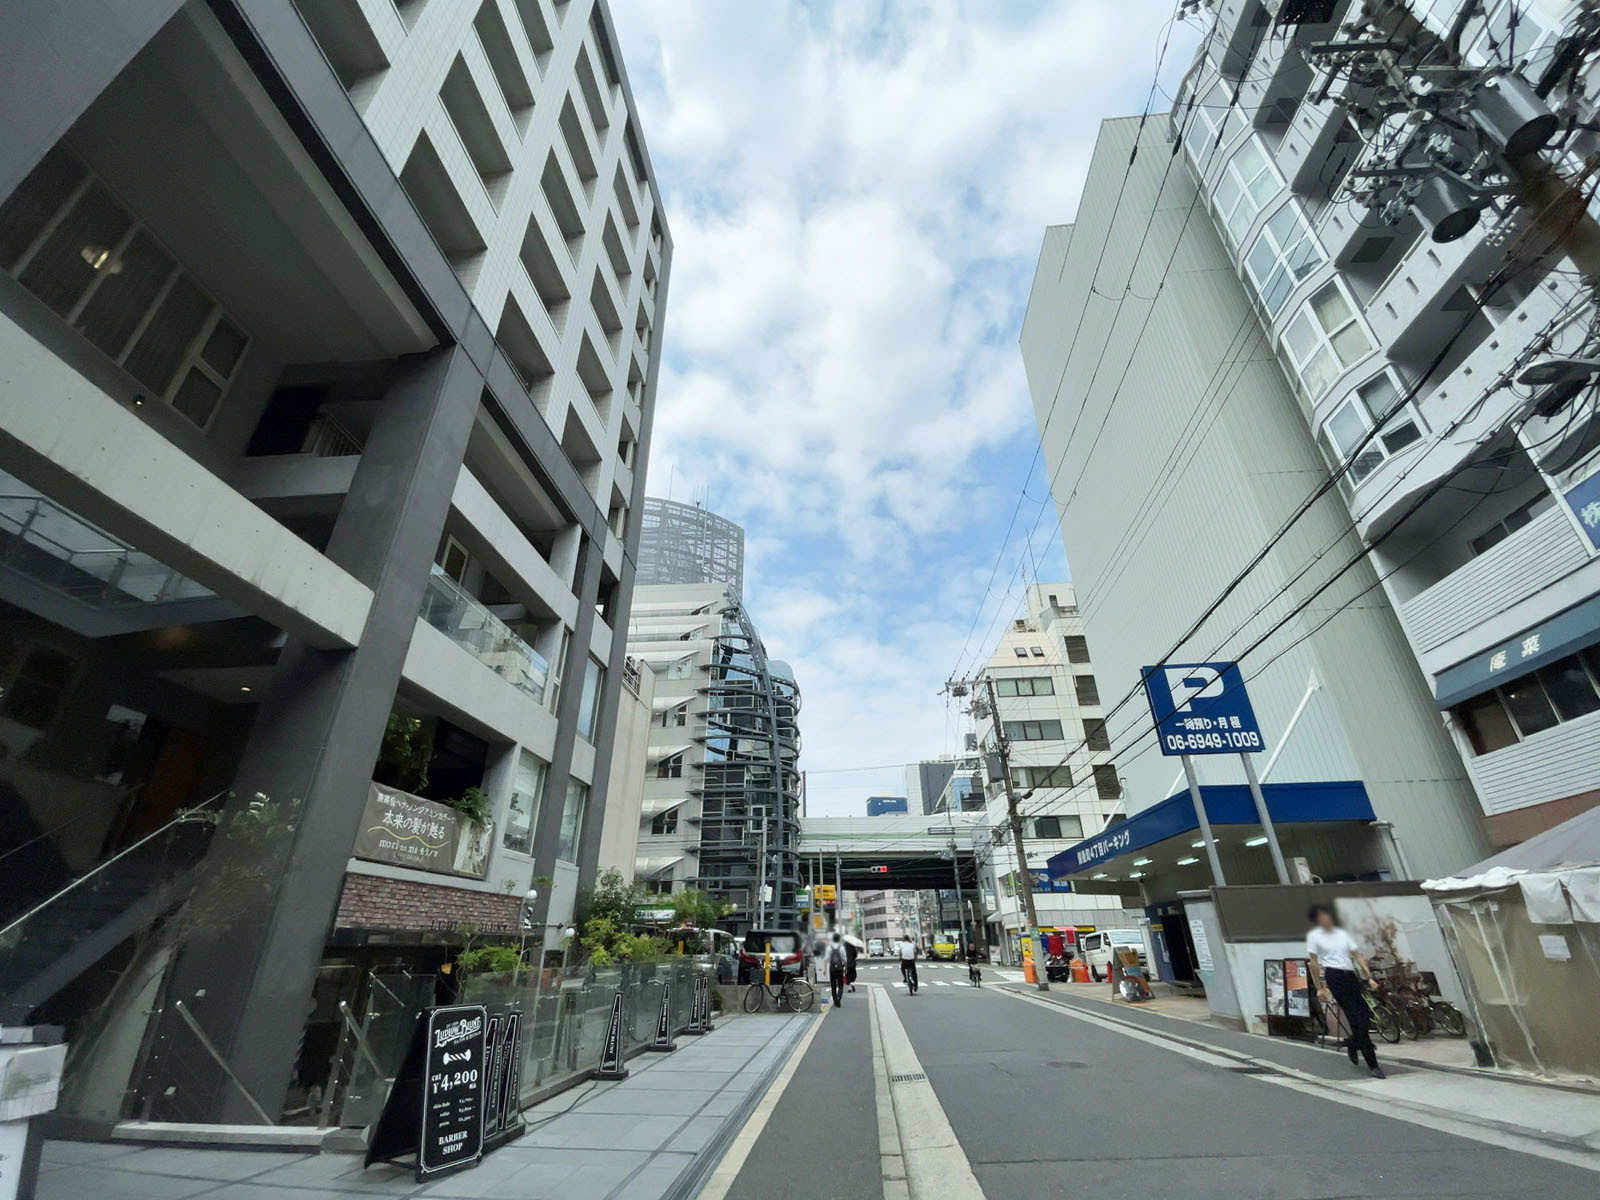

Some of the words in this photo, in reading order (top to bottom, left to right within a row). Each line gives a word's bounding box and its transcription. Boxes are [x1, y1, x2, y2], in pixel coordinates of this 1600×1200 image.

[1164, 667, 1224, 712] P
[1166, 731, 1261, 751] 06-6949-1009
[438, 1130, 468, 1146] BARBER
[442, 1142, 464, 1156] SHOP
